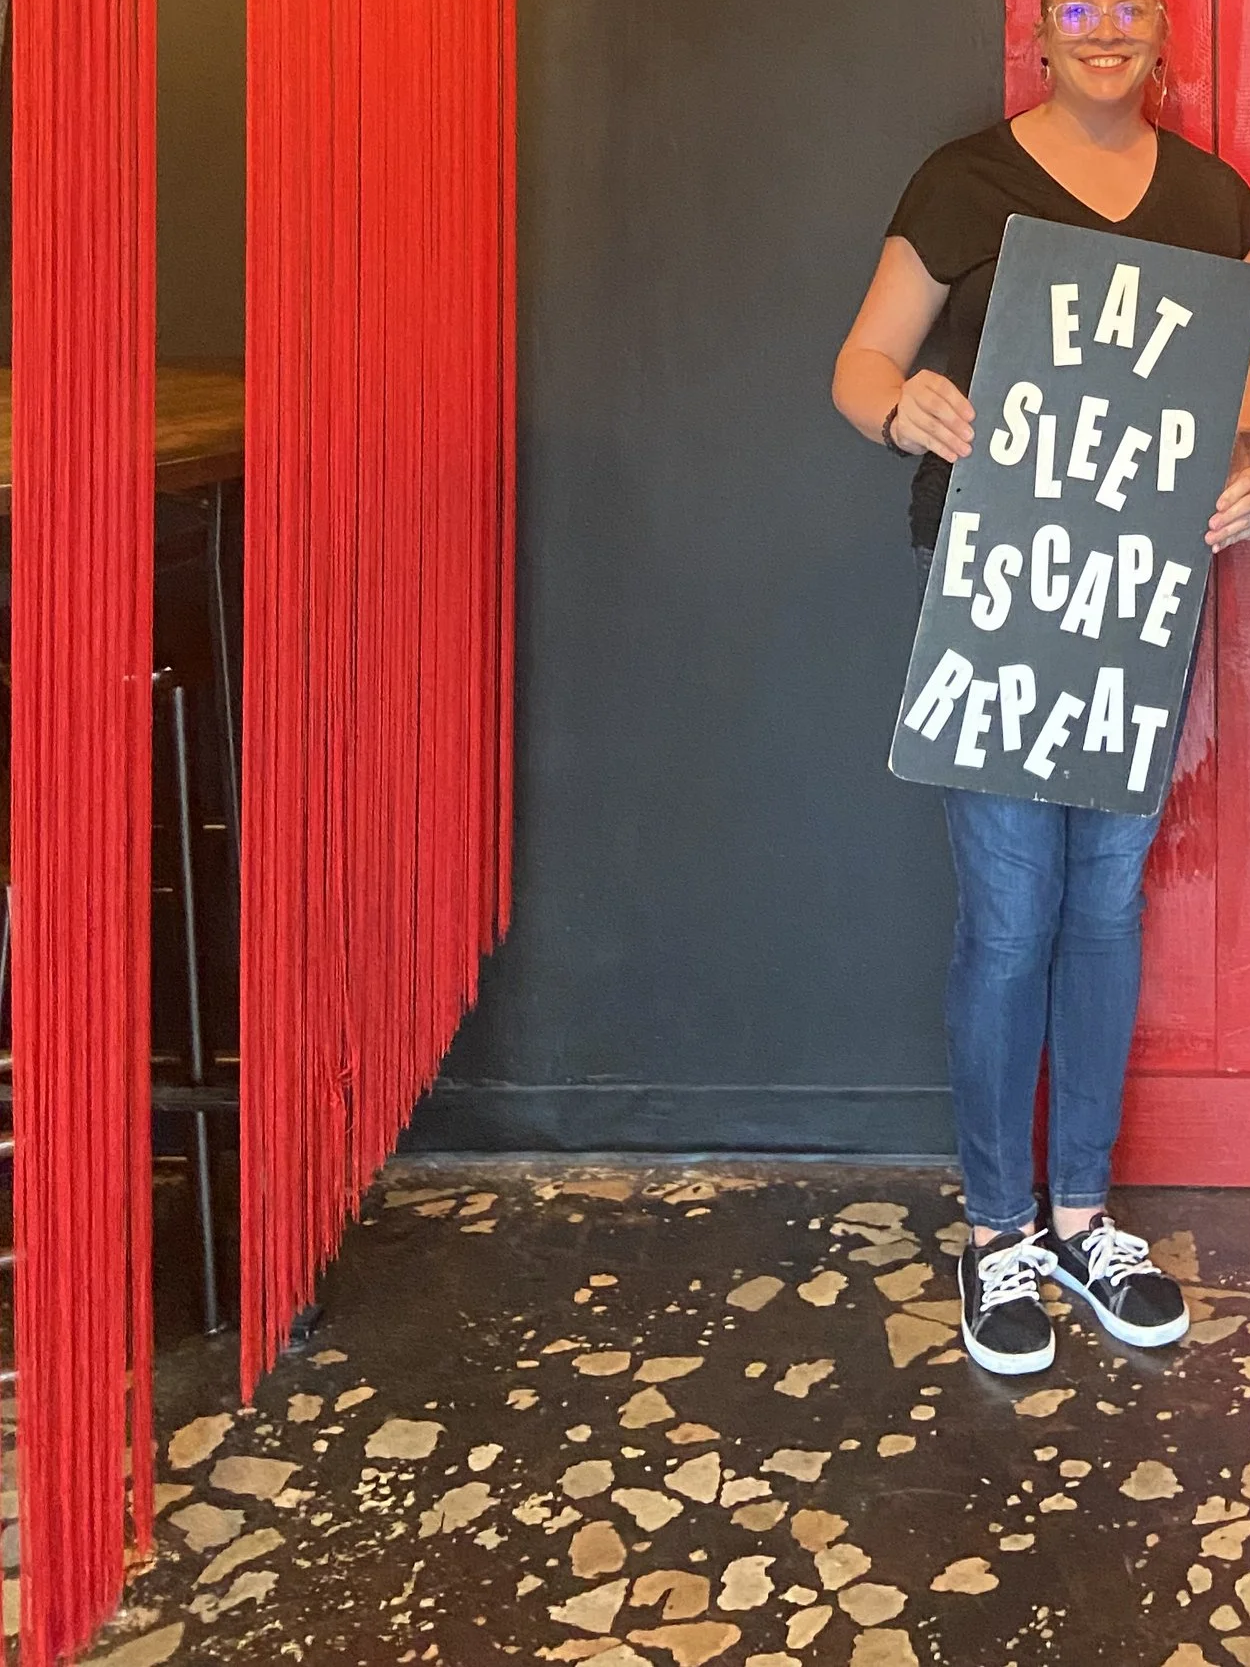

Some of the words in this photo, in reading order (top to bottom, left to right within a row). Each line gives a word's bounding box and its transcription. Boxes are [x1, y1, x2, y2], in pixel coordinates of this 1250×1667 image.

[1050, 263, 1194, 379] EAT
[989, 381, 1196, 512] SLEEP
[941, 510, 1193, 649] ESCAPE
[903, 648, 1169, 793] REPEAT
